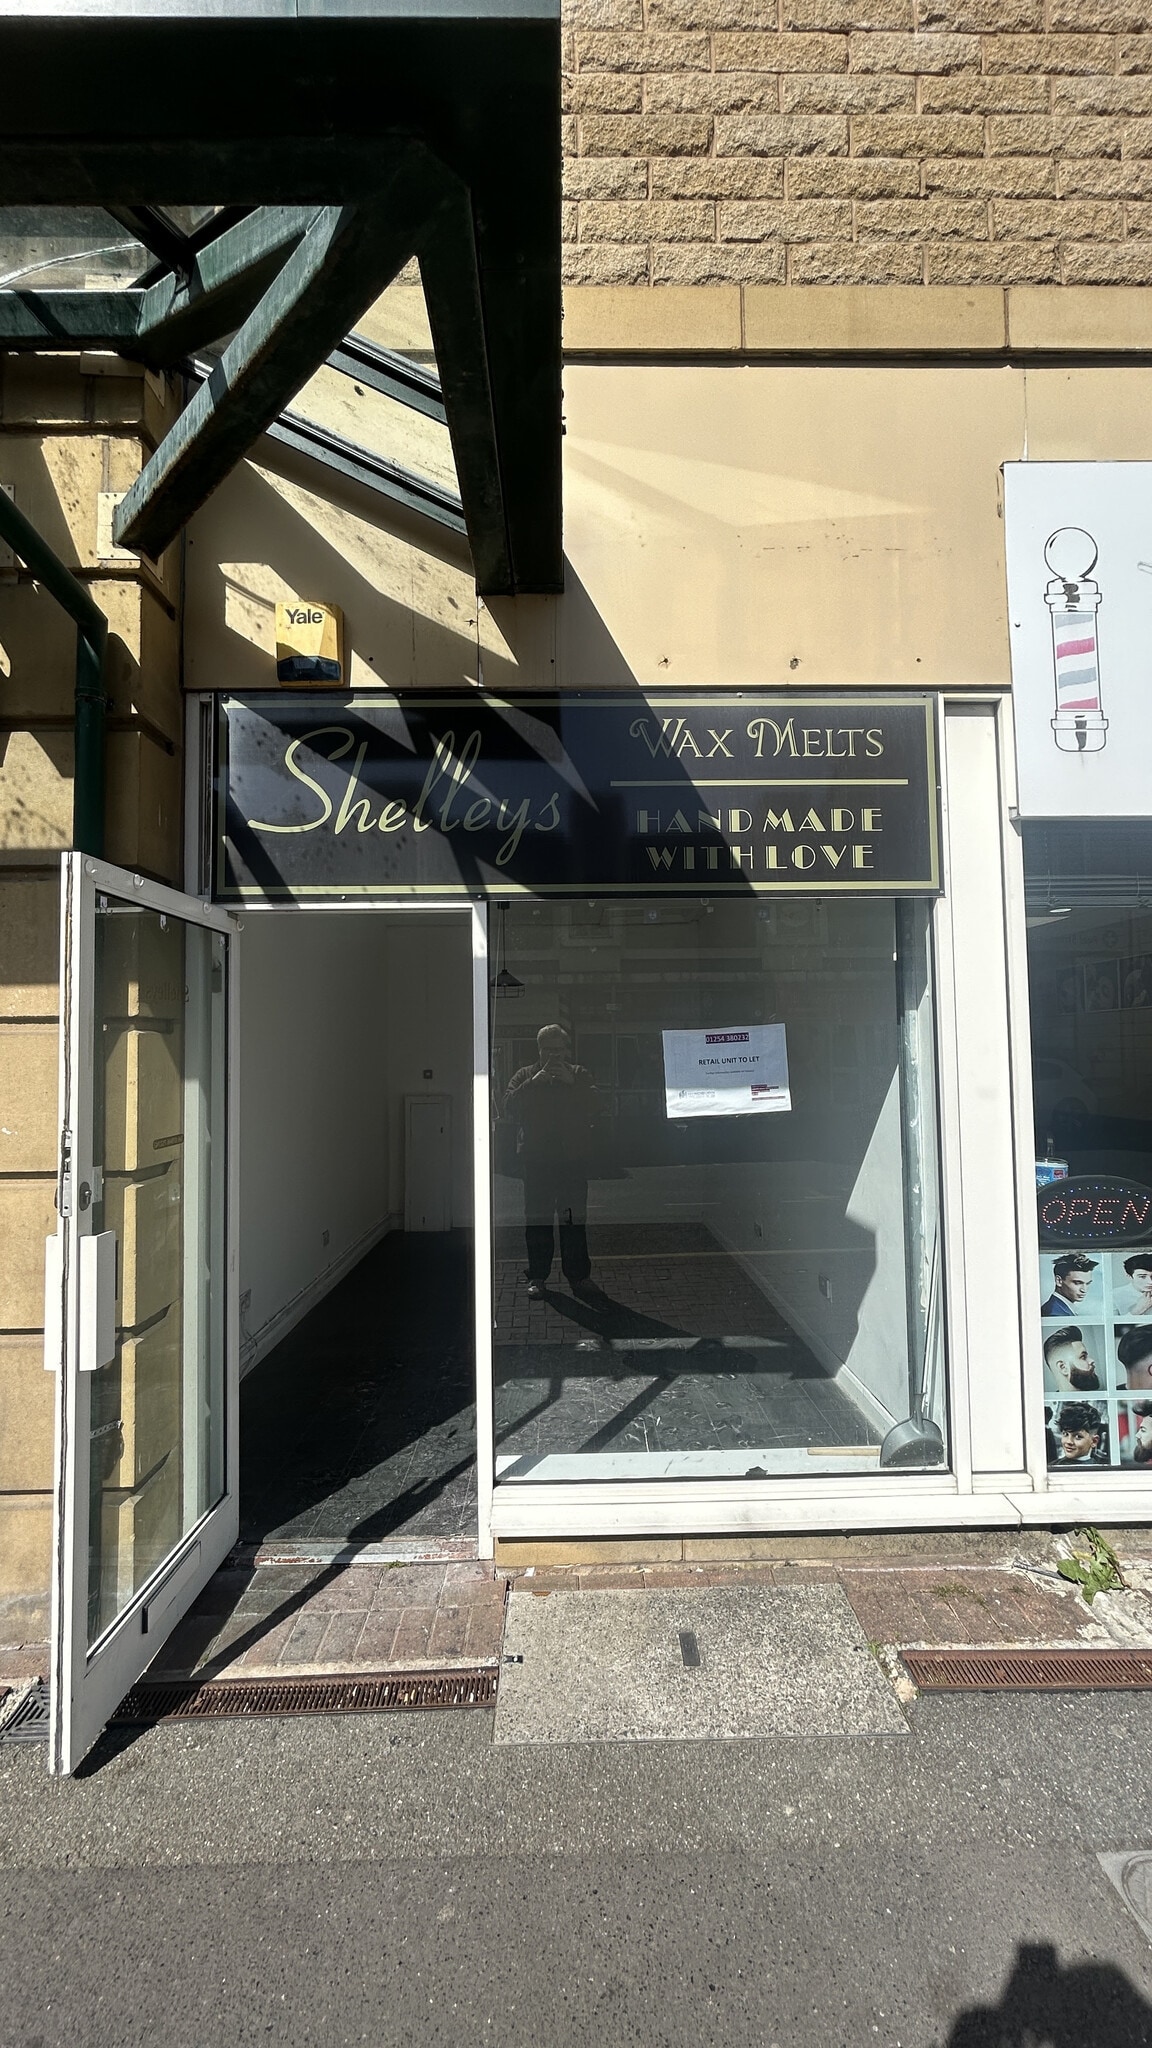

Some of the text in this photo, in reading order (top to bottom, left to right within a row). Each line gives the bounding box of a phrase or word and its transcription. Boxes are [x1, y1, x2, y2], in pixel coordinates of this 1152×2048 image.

[285, 608, 323, 624] Yale
[247, 727, 560, 866] Shelleys
[1042, 1199, 1151, 1225] OPEN
